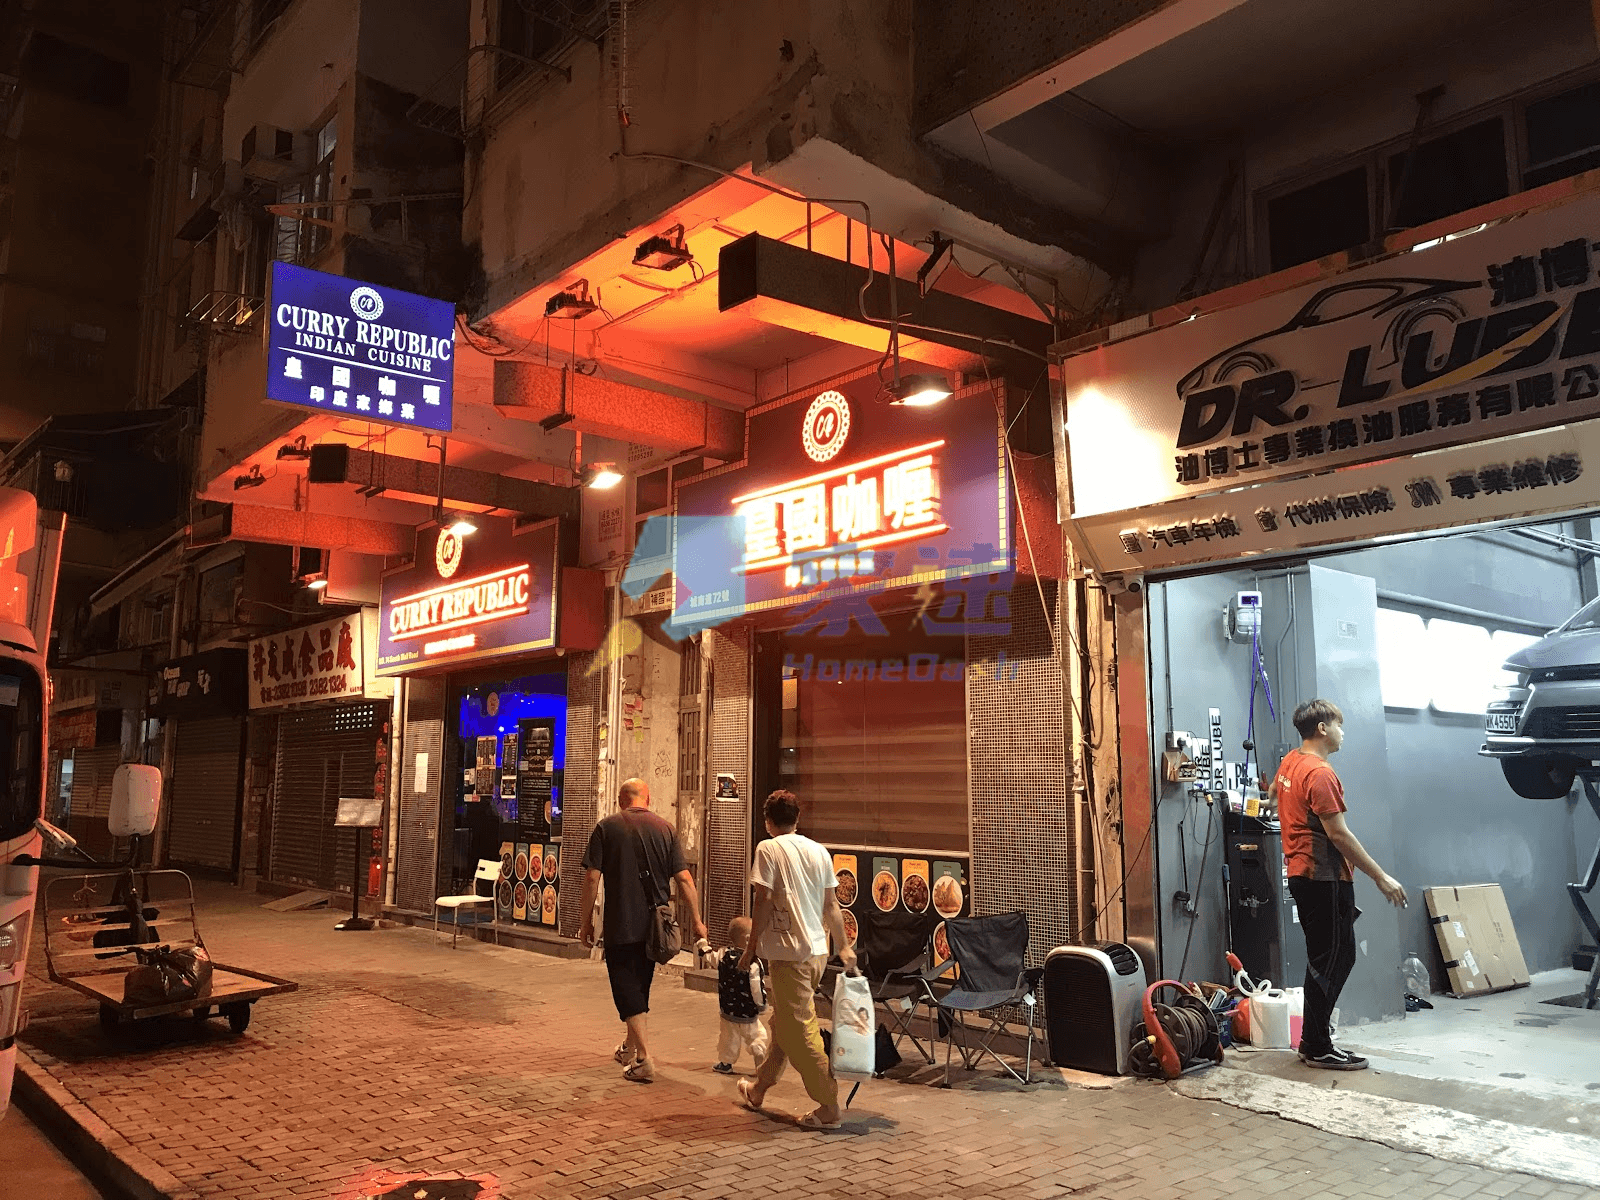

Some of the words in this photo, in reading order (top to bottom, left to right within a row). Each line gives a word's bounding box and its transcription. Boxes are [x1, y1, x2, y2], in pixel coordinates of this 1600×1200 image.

[1487, 238, 1600, 307] 油博
[276, 303, 350, 339] CURRY
[356, 320, 451, 361] REPUBLIC
[295, 331, 356, 357] INDIAN
[367, 347, 432, 373] CUISINE
[1176, 369, 1309, 449] DR.
[1147, 515, 1240, 549] 汽車年檢
[1284, 488, 1396, 528] 代辦保險
[1446, 457, 1582, 500] 專業維修
[389, 597, 443, 634] CURRY
[441, 573, 529, 622] REPUBLIC
[1211, 715, 1223, 761] LUBE
[1214, 768, 1224, 790] DR
